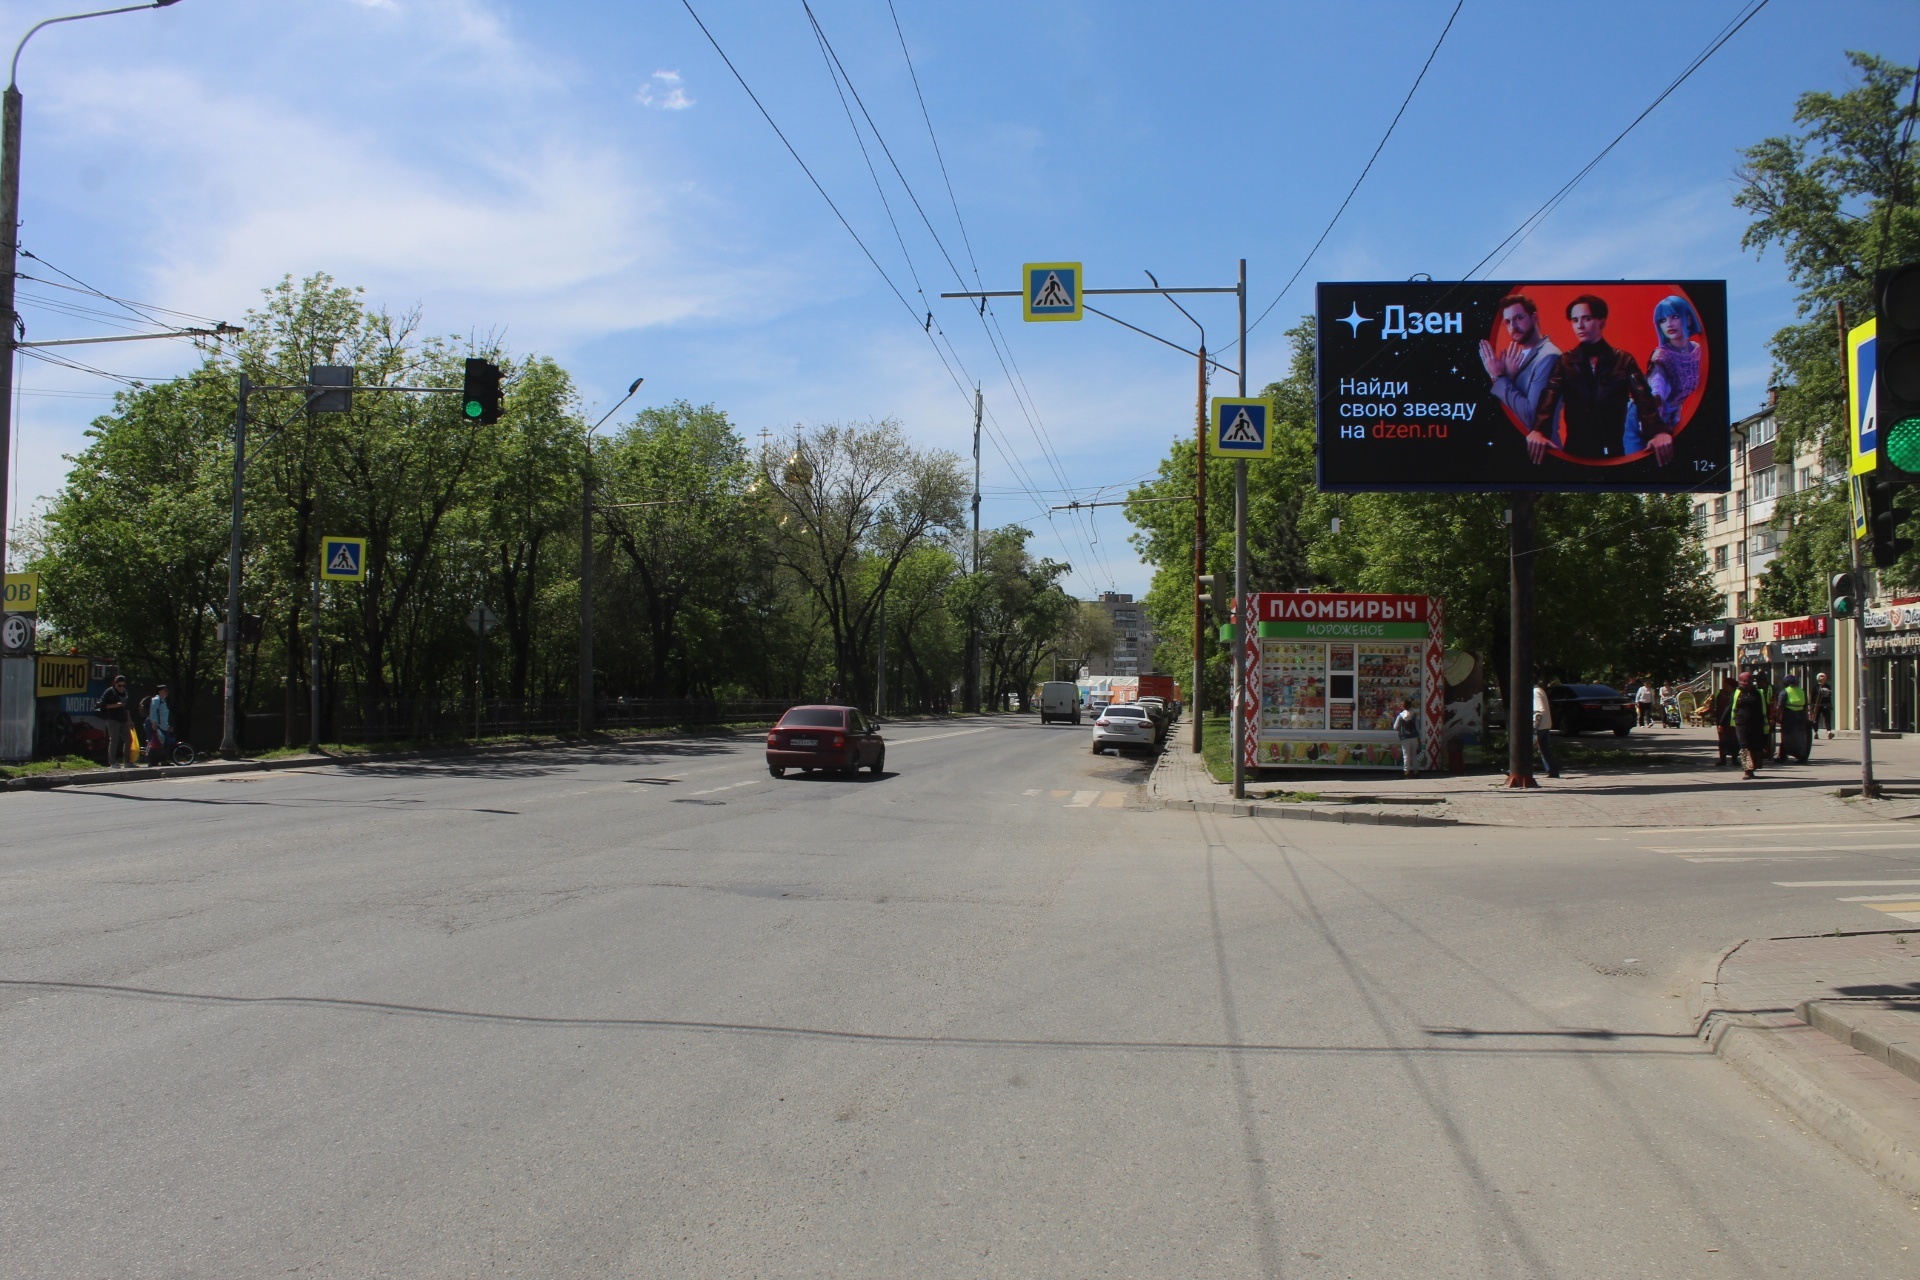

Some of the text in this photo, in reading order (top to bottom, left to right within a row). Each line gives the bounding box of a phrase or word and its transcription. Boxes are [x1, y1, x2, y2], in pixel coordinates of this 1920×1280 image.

[1381, 304, 1463, 340] Дзен
[1340, 377, 1409, 399] Найди
[1340, 403, 1477, 422] свою звезду
[1340, 420, 1448, 439] на dzen.ru
[1693, 460, 1717, 472] 12+
[4, 584, 32, 601] ОВ
[1270, 600, 1417, 619] ПЛОМБИРЫЧ
[1306, 624, 1384, 636] МОРОЖЕНОЕ
[41, 663, 85, 689] ШИНО
